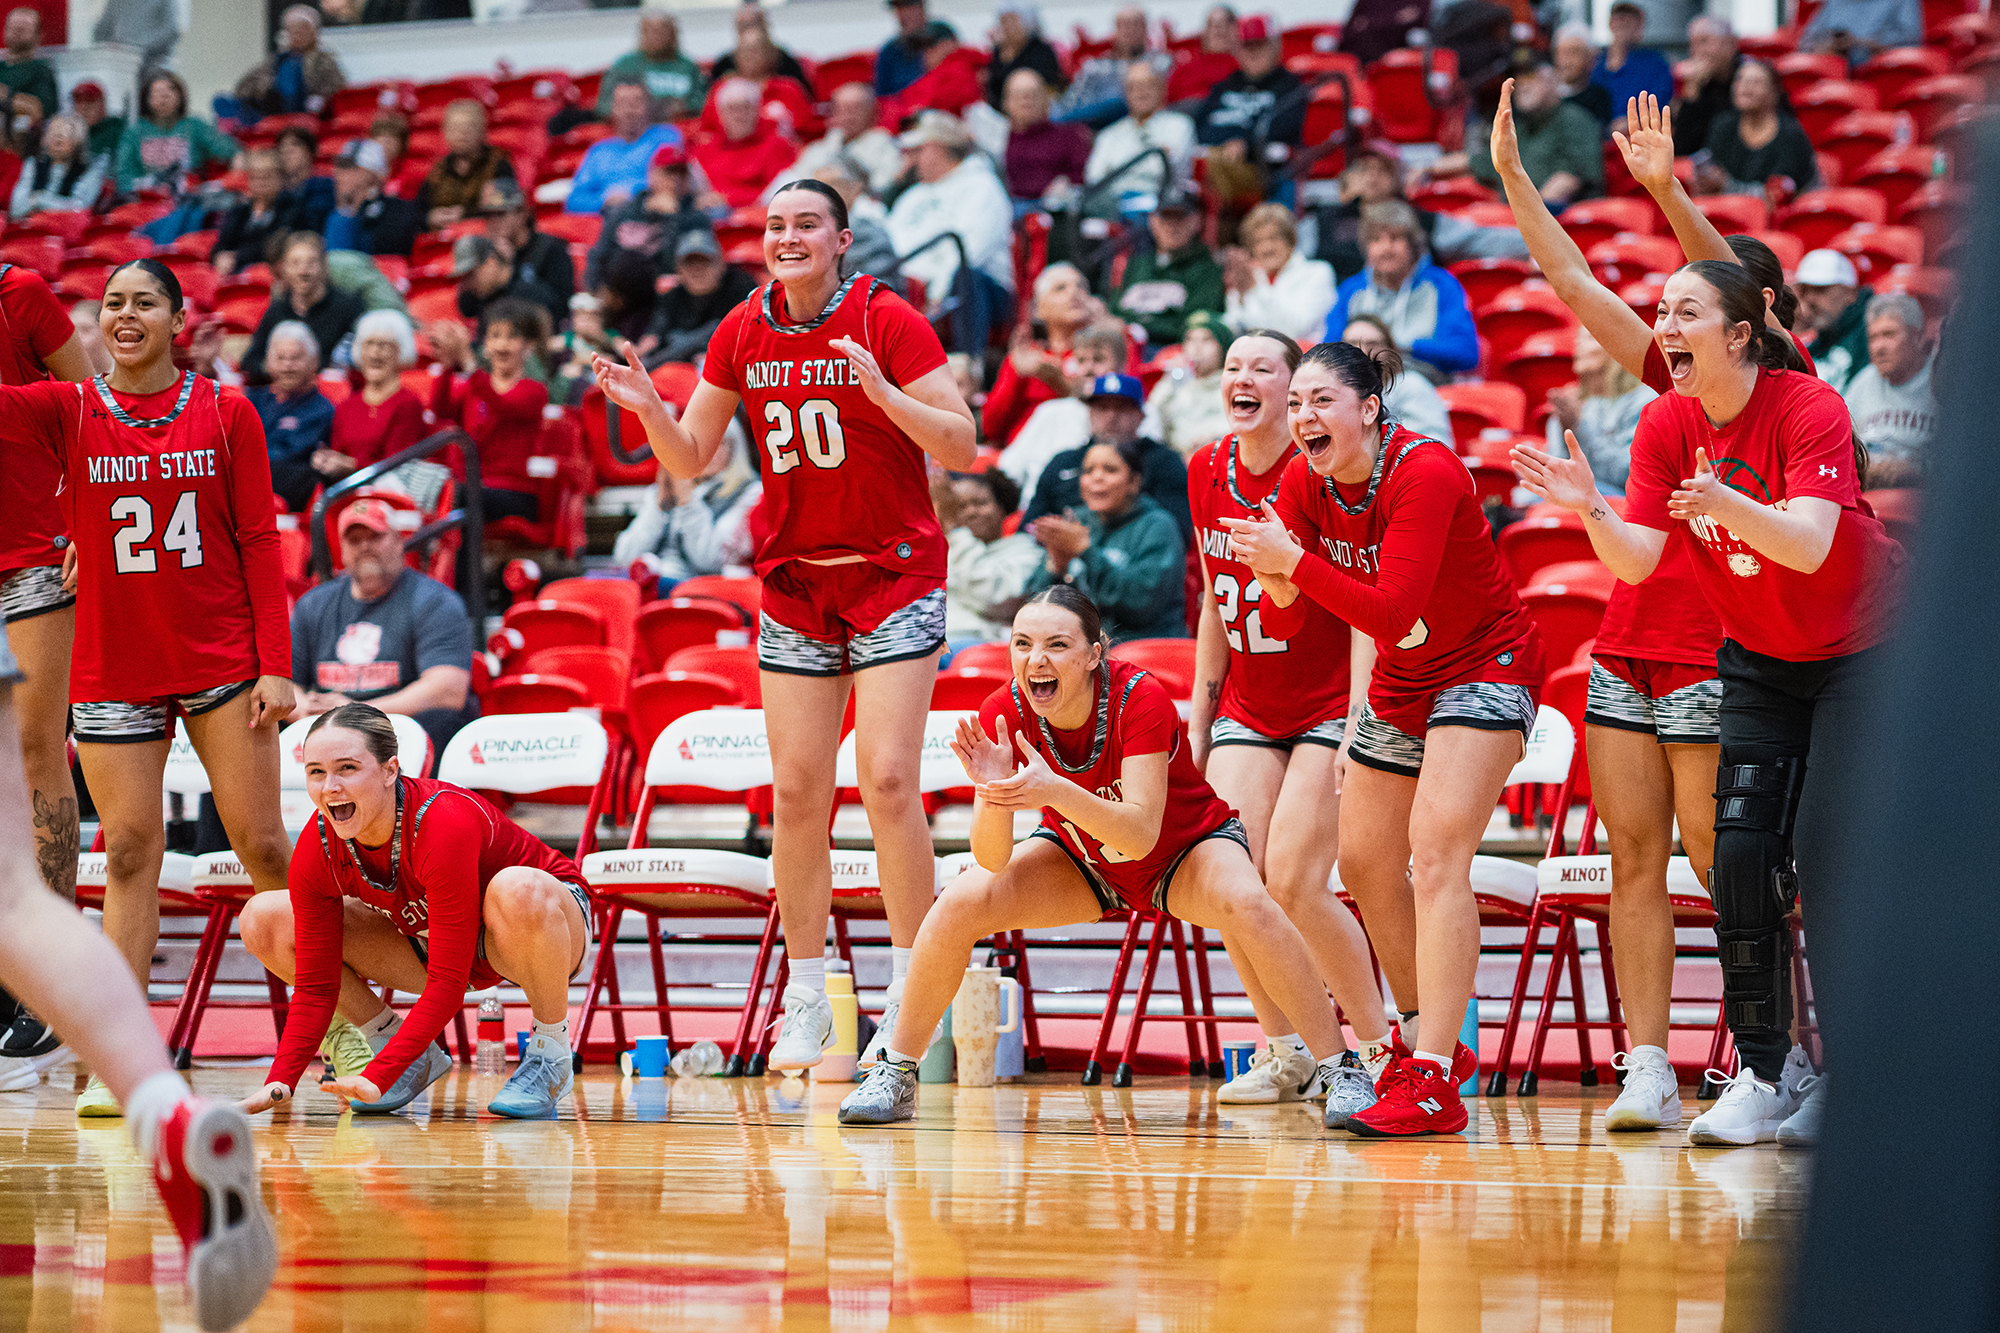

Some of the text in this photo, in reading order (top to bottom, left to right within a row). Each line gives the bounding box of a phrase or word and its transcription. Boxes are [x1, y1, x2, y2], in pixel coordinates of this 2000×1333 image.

[746, 358, 860, 389] MINOT STATE
[764, 398, 847, 475] 20
[87, 449, 216, 484] MINOT STATE
[109, 490, 204, 575] 24
[1213, 572, 1290, 656] 22
[483, 733, 583, 752] PINNACLE
[602, 860, 685, 873] MINOT STATE
[832, 863, 870, 875] STATE
[1560, 867, 1607, 882] MINOT
